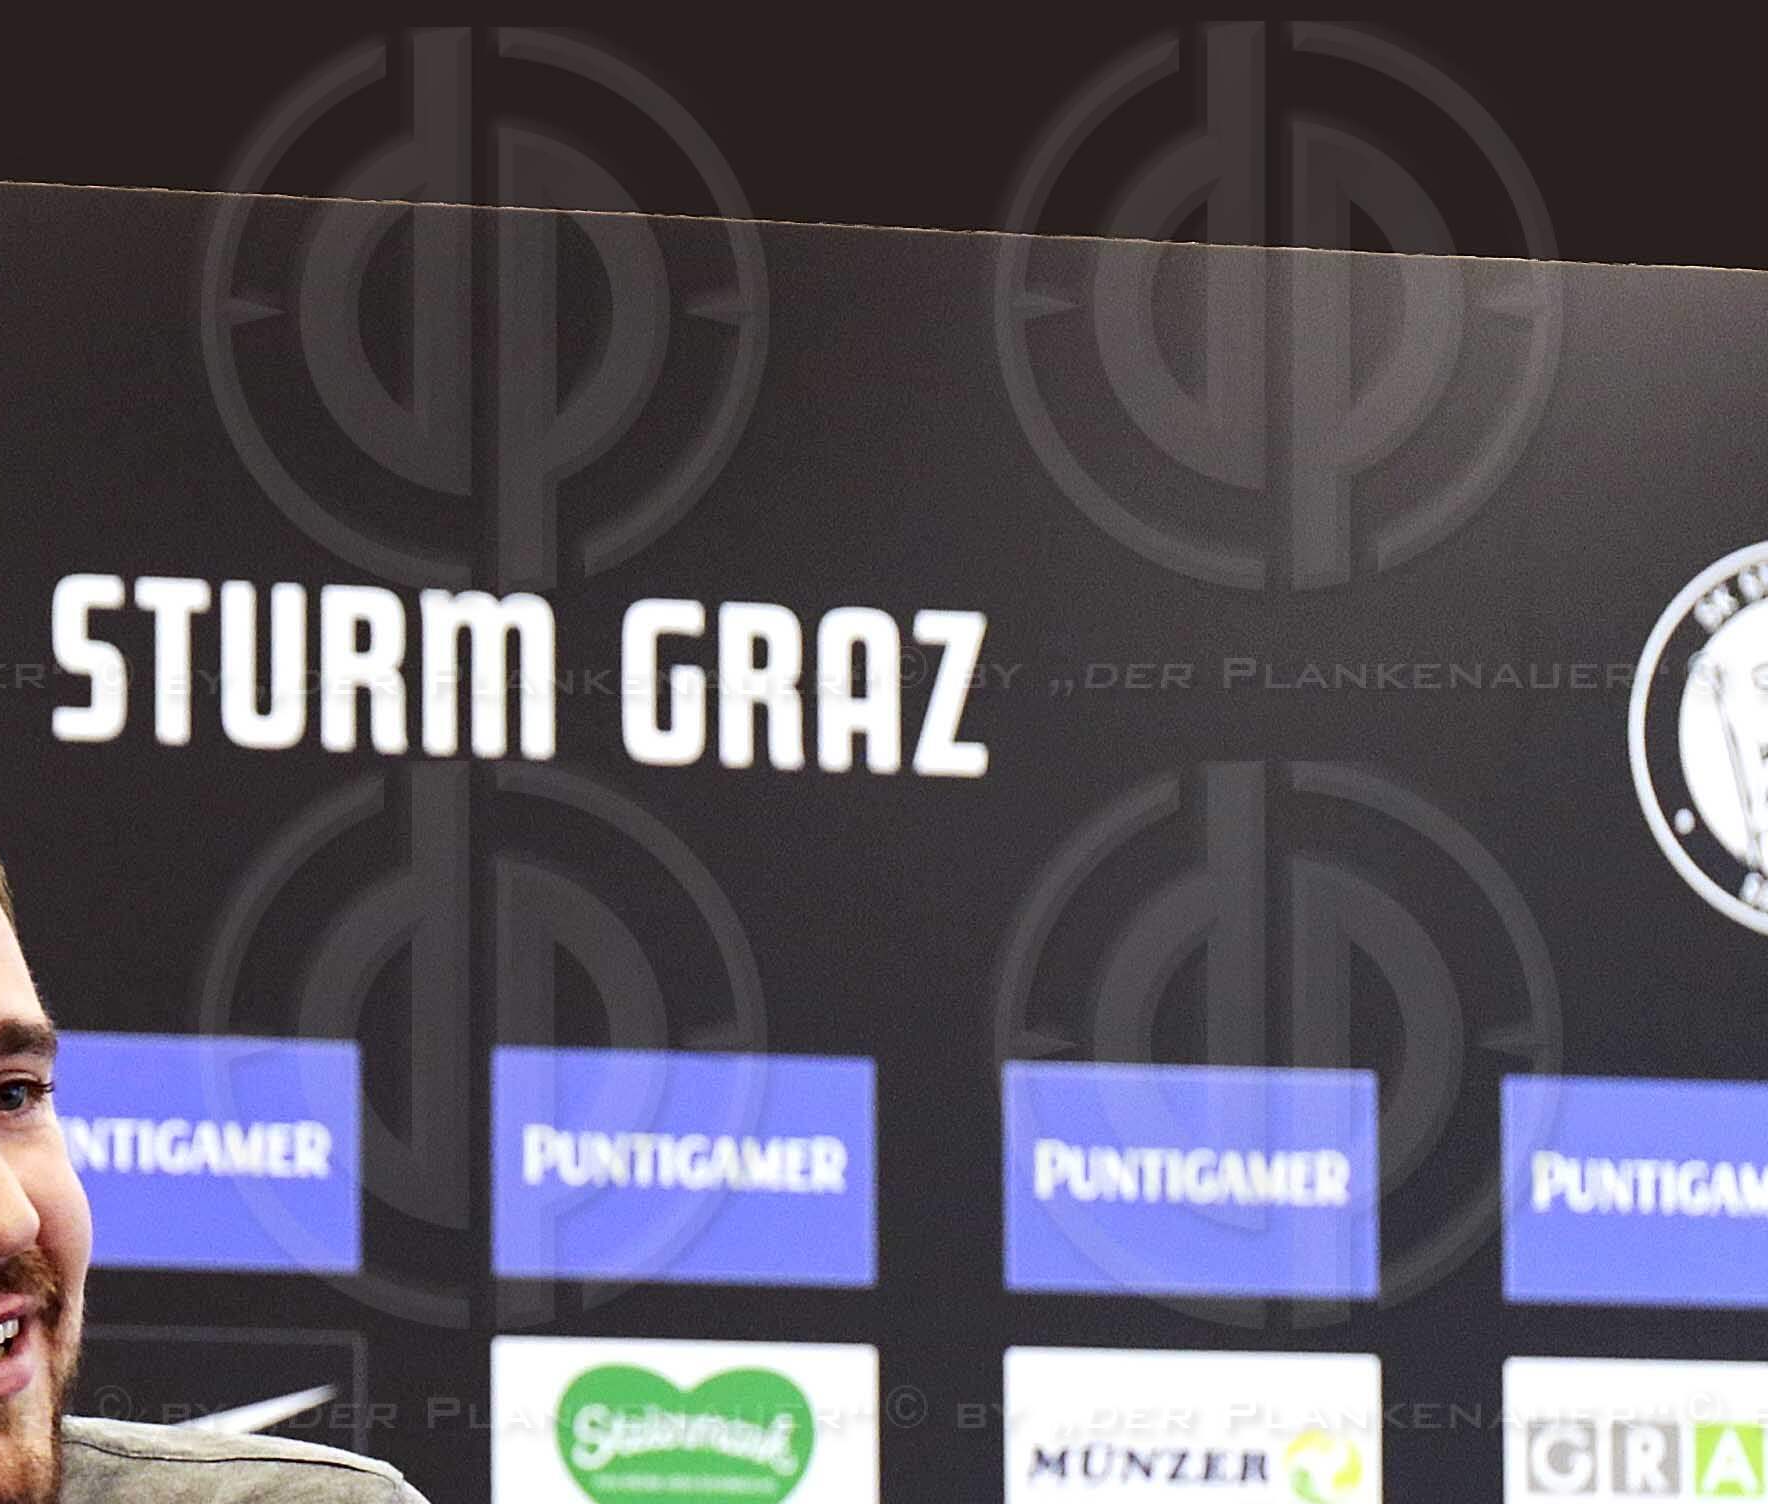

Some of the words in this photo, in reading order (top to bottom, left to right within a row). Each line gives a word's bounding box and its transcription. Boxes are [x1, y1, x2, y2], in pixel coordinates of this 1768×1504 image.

[51, 573, 556, 760] STURM
[621, 598, 989, 780] GRAZ
[522, 1123, 846, 1193] PUNTIGAMER
[1035, 1139, 1350, 1207] PUNTIGAMER
[1029, 1438, 1270, 1486] MÜNZER
